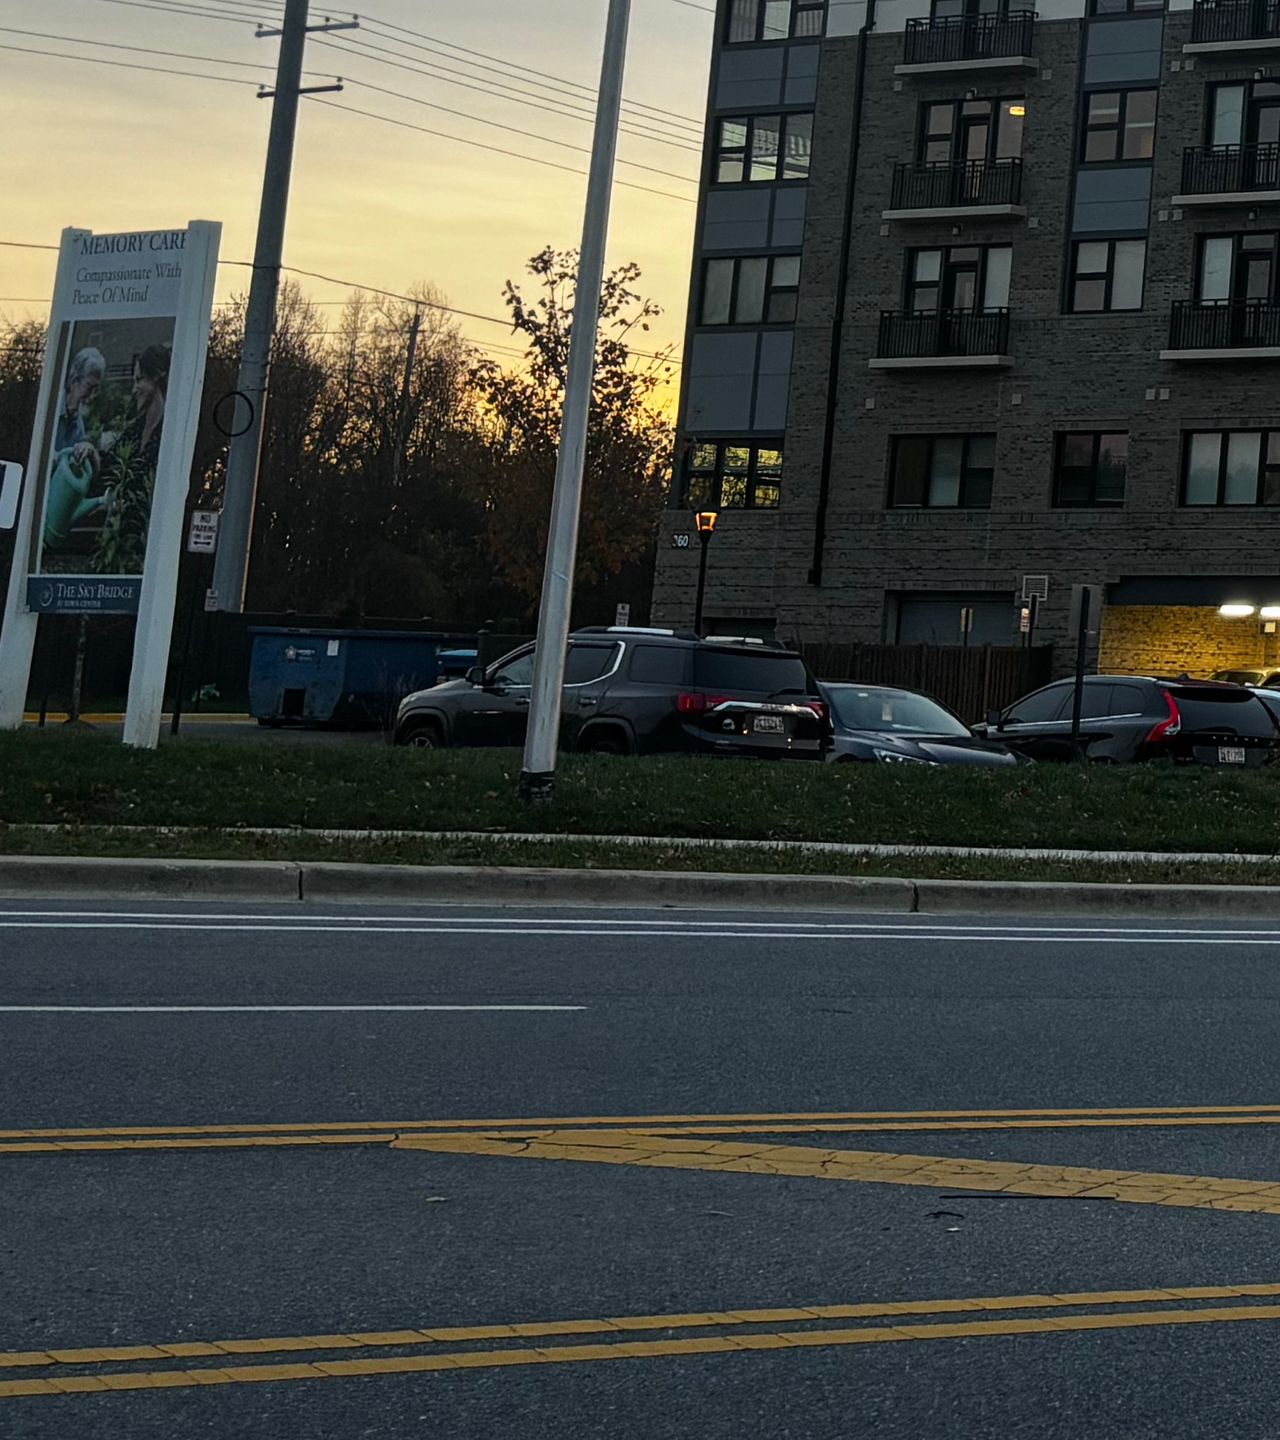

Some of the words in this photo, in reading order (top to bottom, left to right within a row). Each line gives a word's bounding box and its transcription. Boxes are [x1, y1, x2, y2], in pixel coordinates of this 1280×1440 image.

[80, 234, 148, 255] MEMORY
[76, 266, 152, 287] Compassionate
[155, 262, 182, 278] With
[72, 289, 99, 305] Peace
[102, 286, 119, 304] Of
[119, 285, 149, 303] Mind
[57, 582, 77, 598] THE
[77, 583, 96, 598] SKY
[97, 584, 134, 598] BRIDGE
